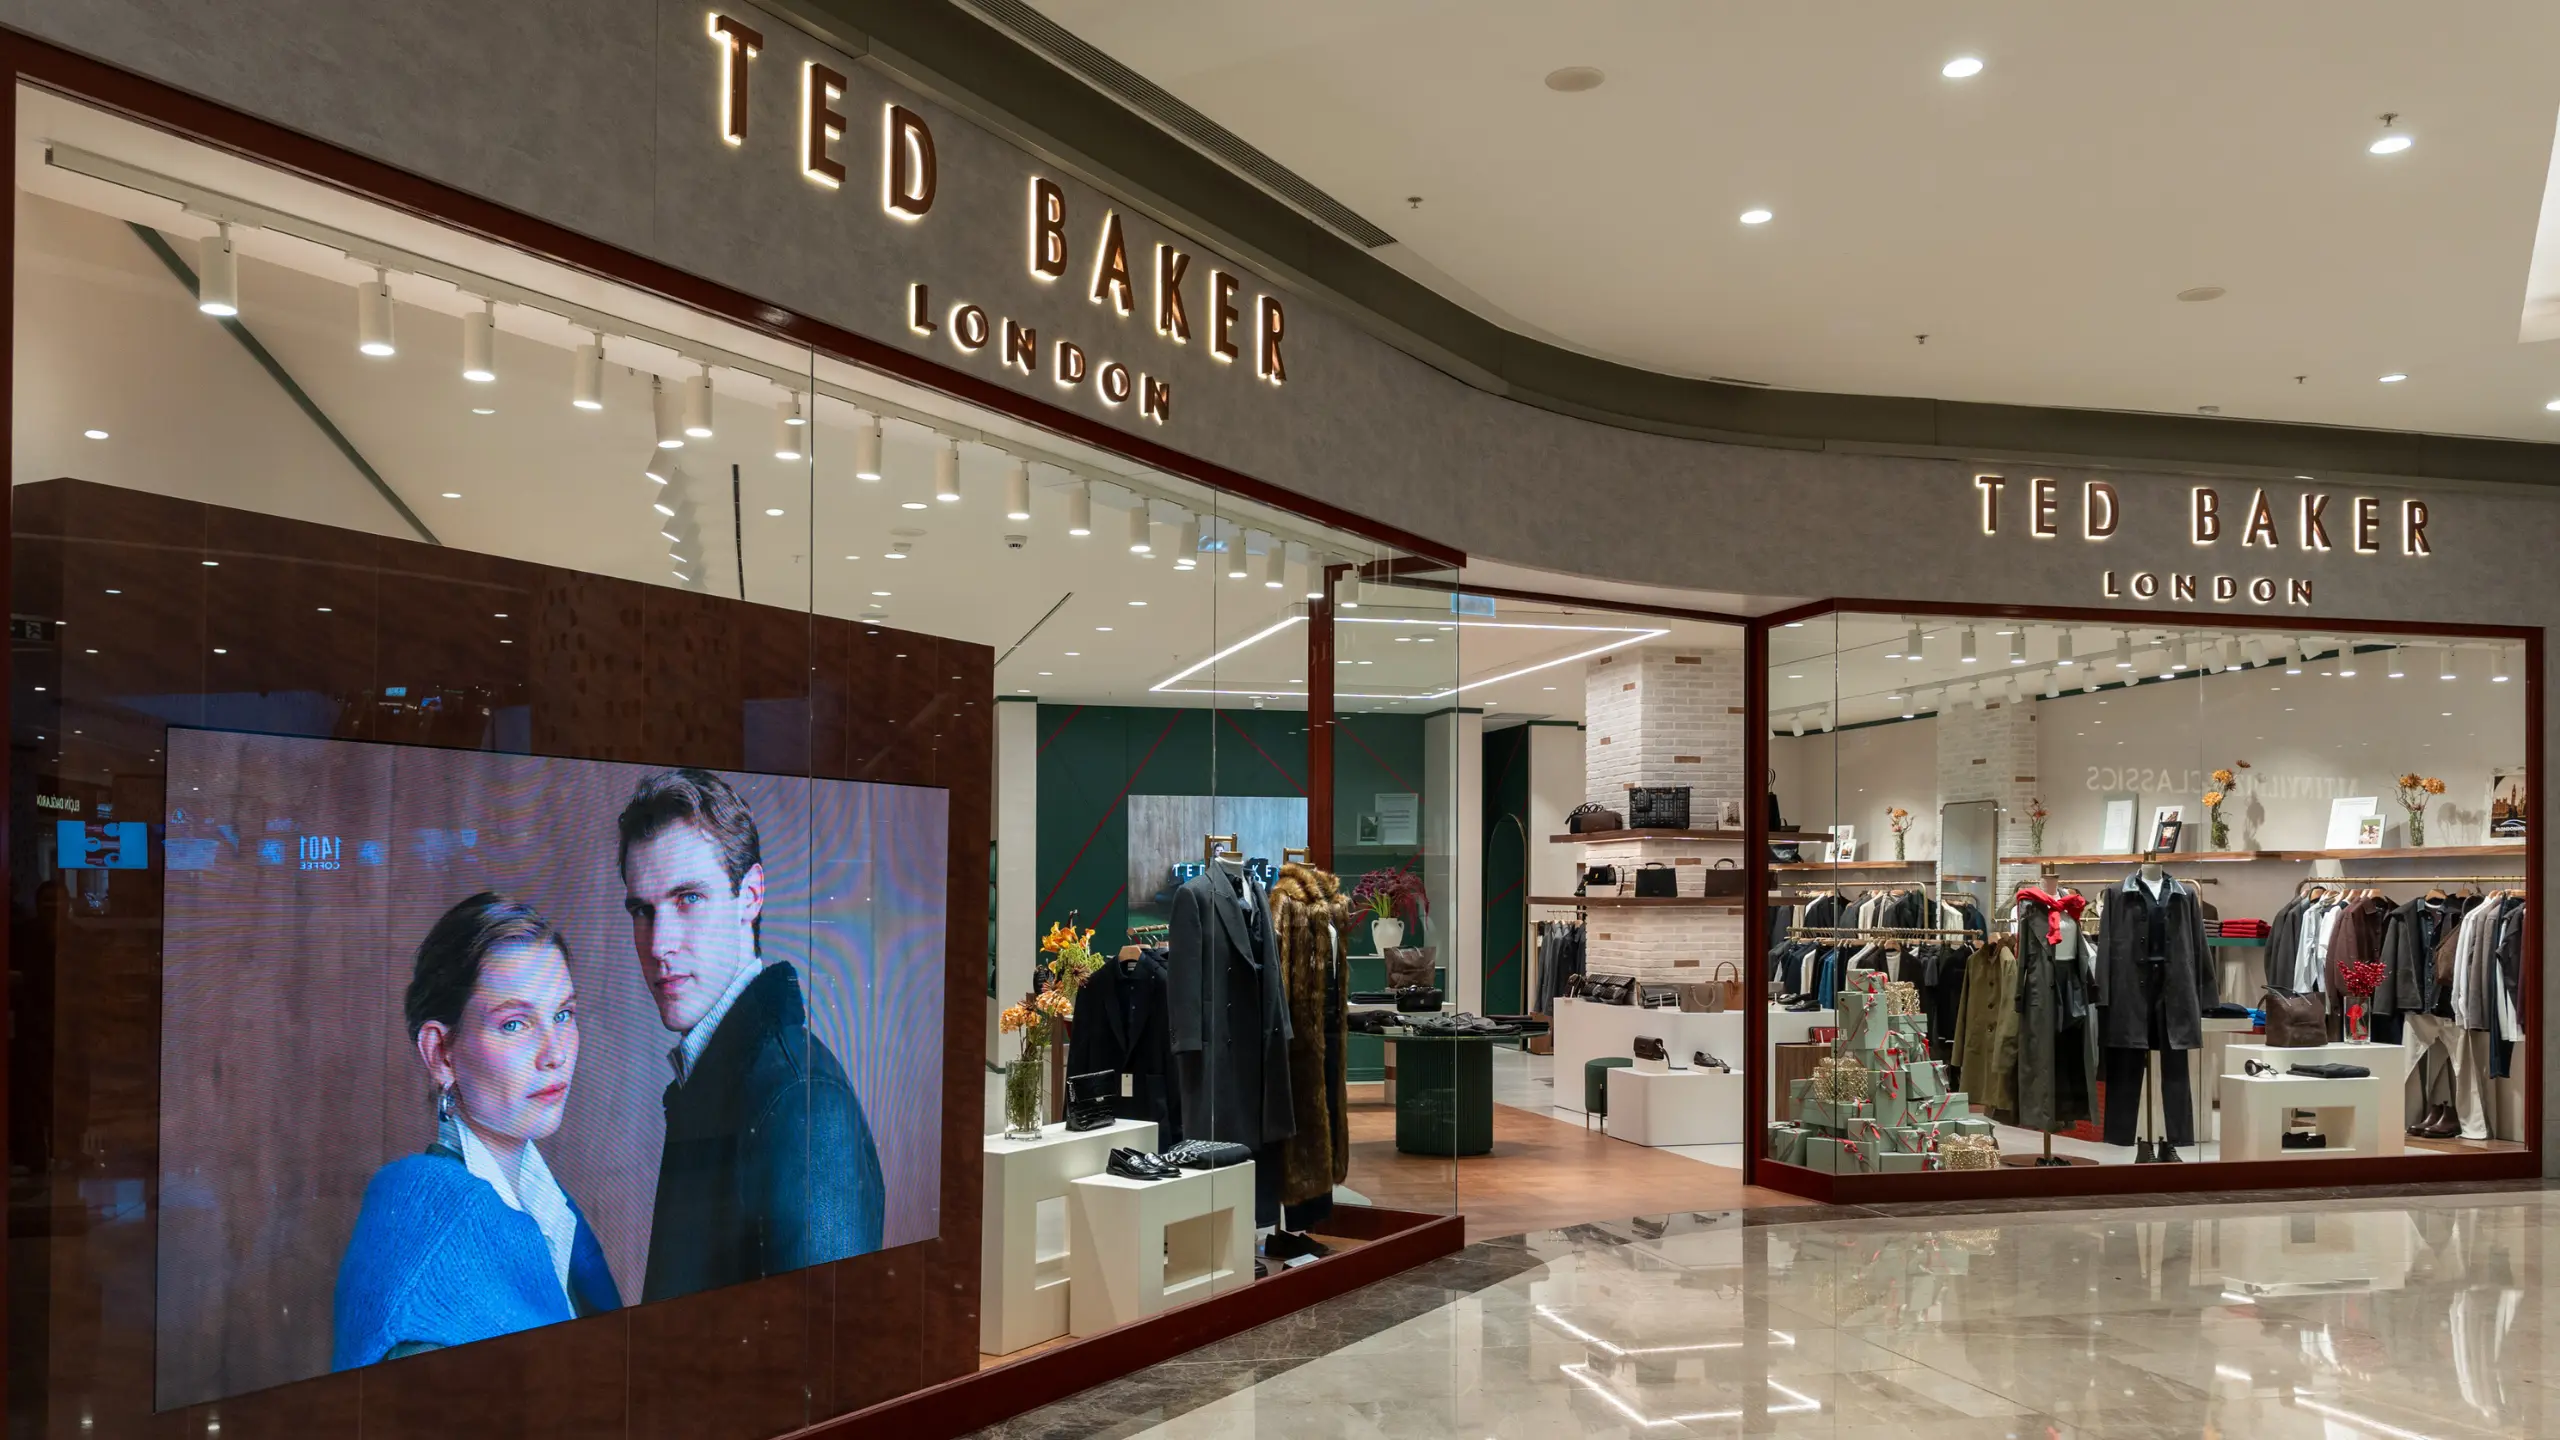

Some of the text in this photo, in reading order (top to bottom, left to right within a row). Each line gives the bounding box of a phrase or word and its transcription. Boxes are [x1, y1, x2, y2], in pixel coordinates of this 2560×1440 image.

[708, 12, 1287, 385] TED BAKER
[909, 282, 1171, 424] LONDON
[1974, 474, 2432, 556] TED BAKER
[2103, 570, 2313, 606] LONDON
